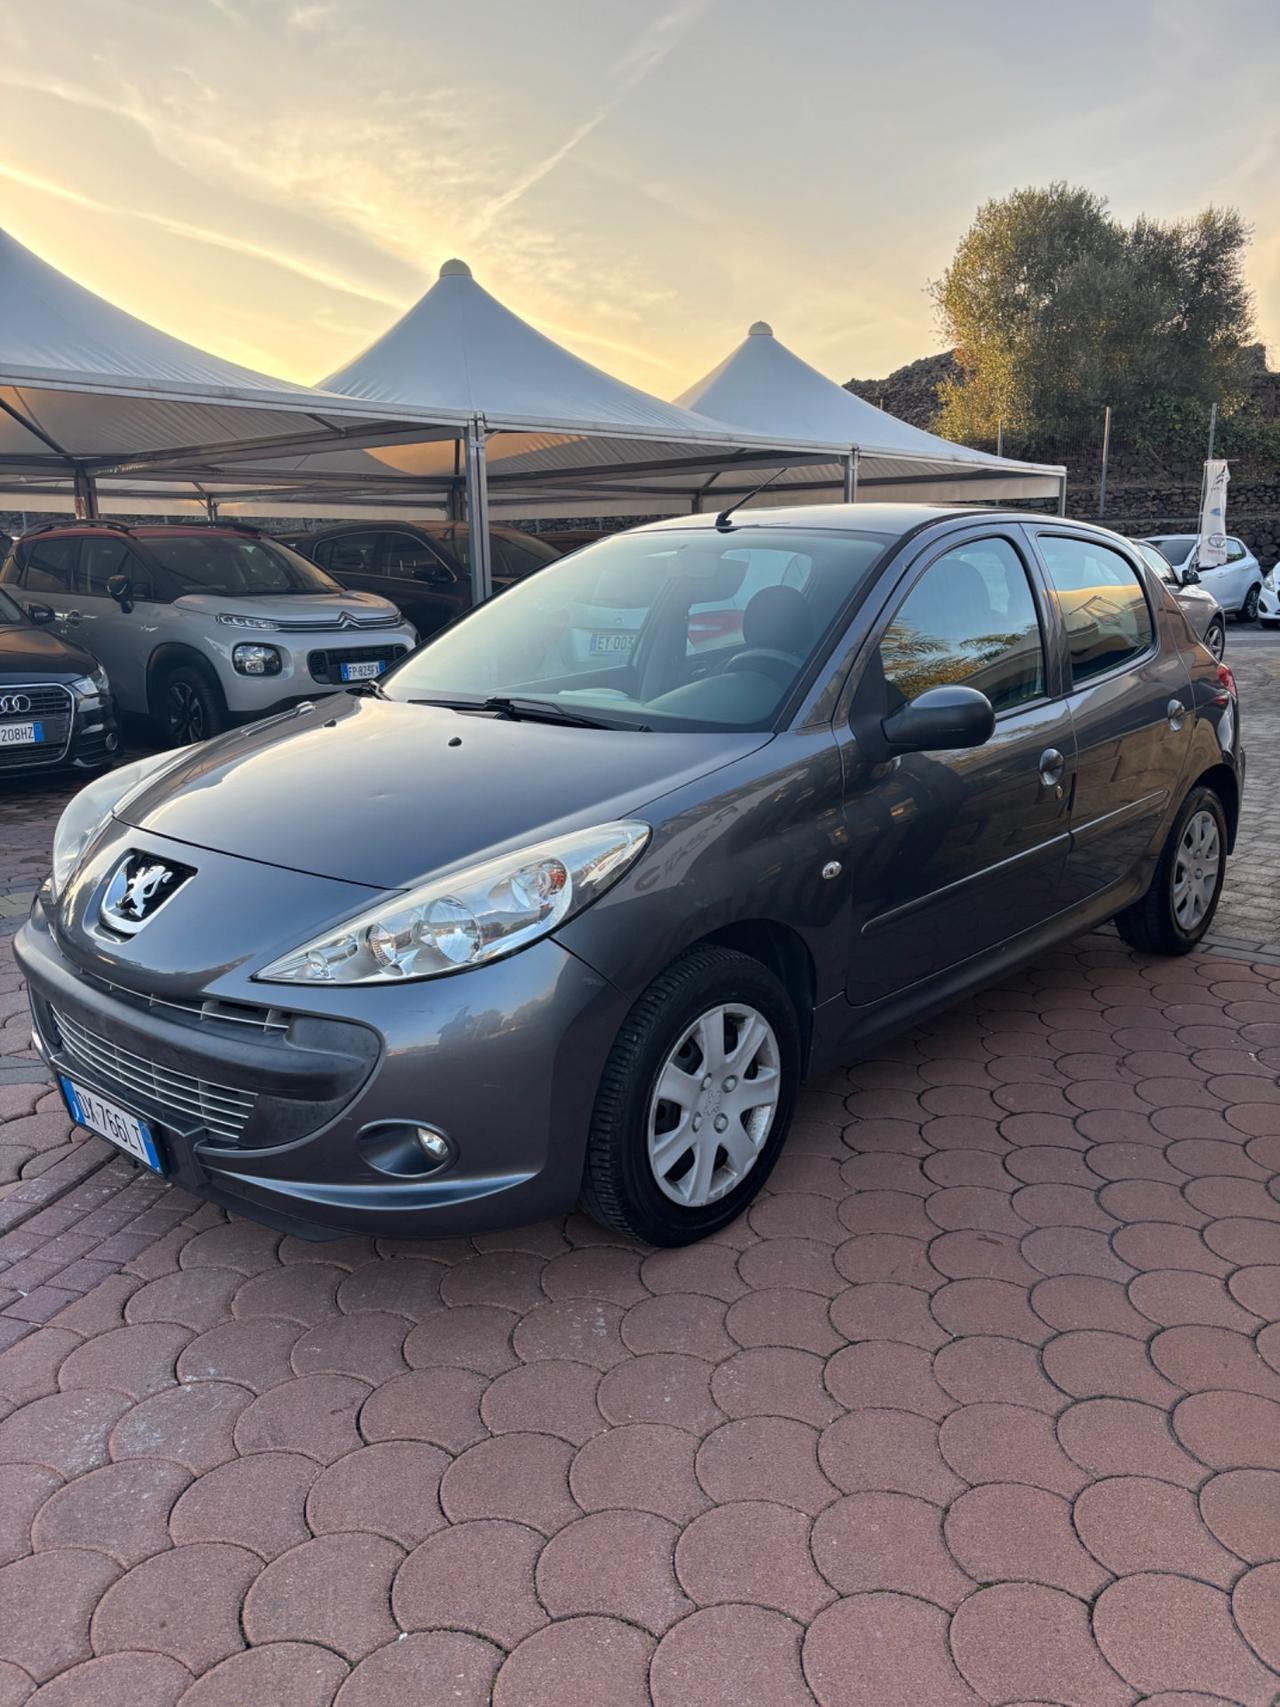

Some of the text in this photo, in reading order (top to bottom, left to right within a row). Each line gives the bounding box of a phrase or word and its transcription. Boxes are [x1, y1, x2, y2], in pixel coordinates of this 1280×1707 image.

[1, 726, 33, 742] 208HZ
[75, 1090, 145, 1154] DX 766LT
